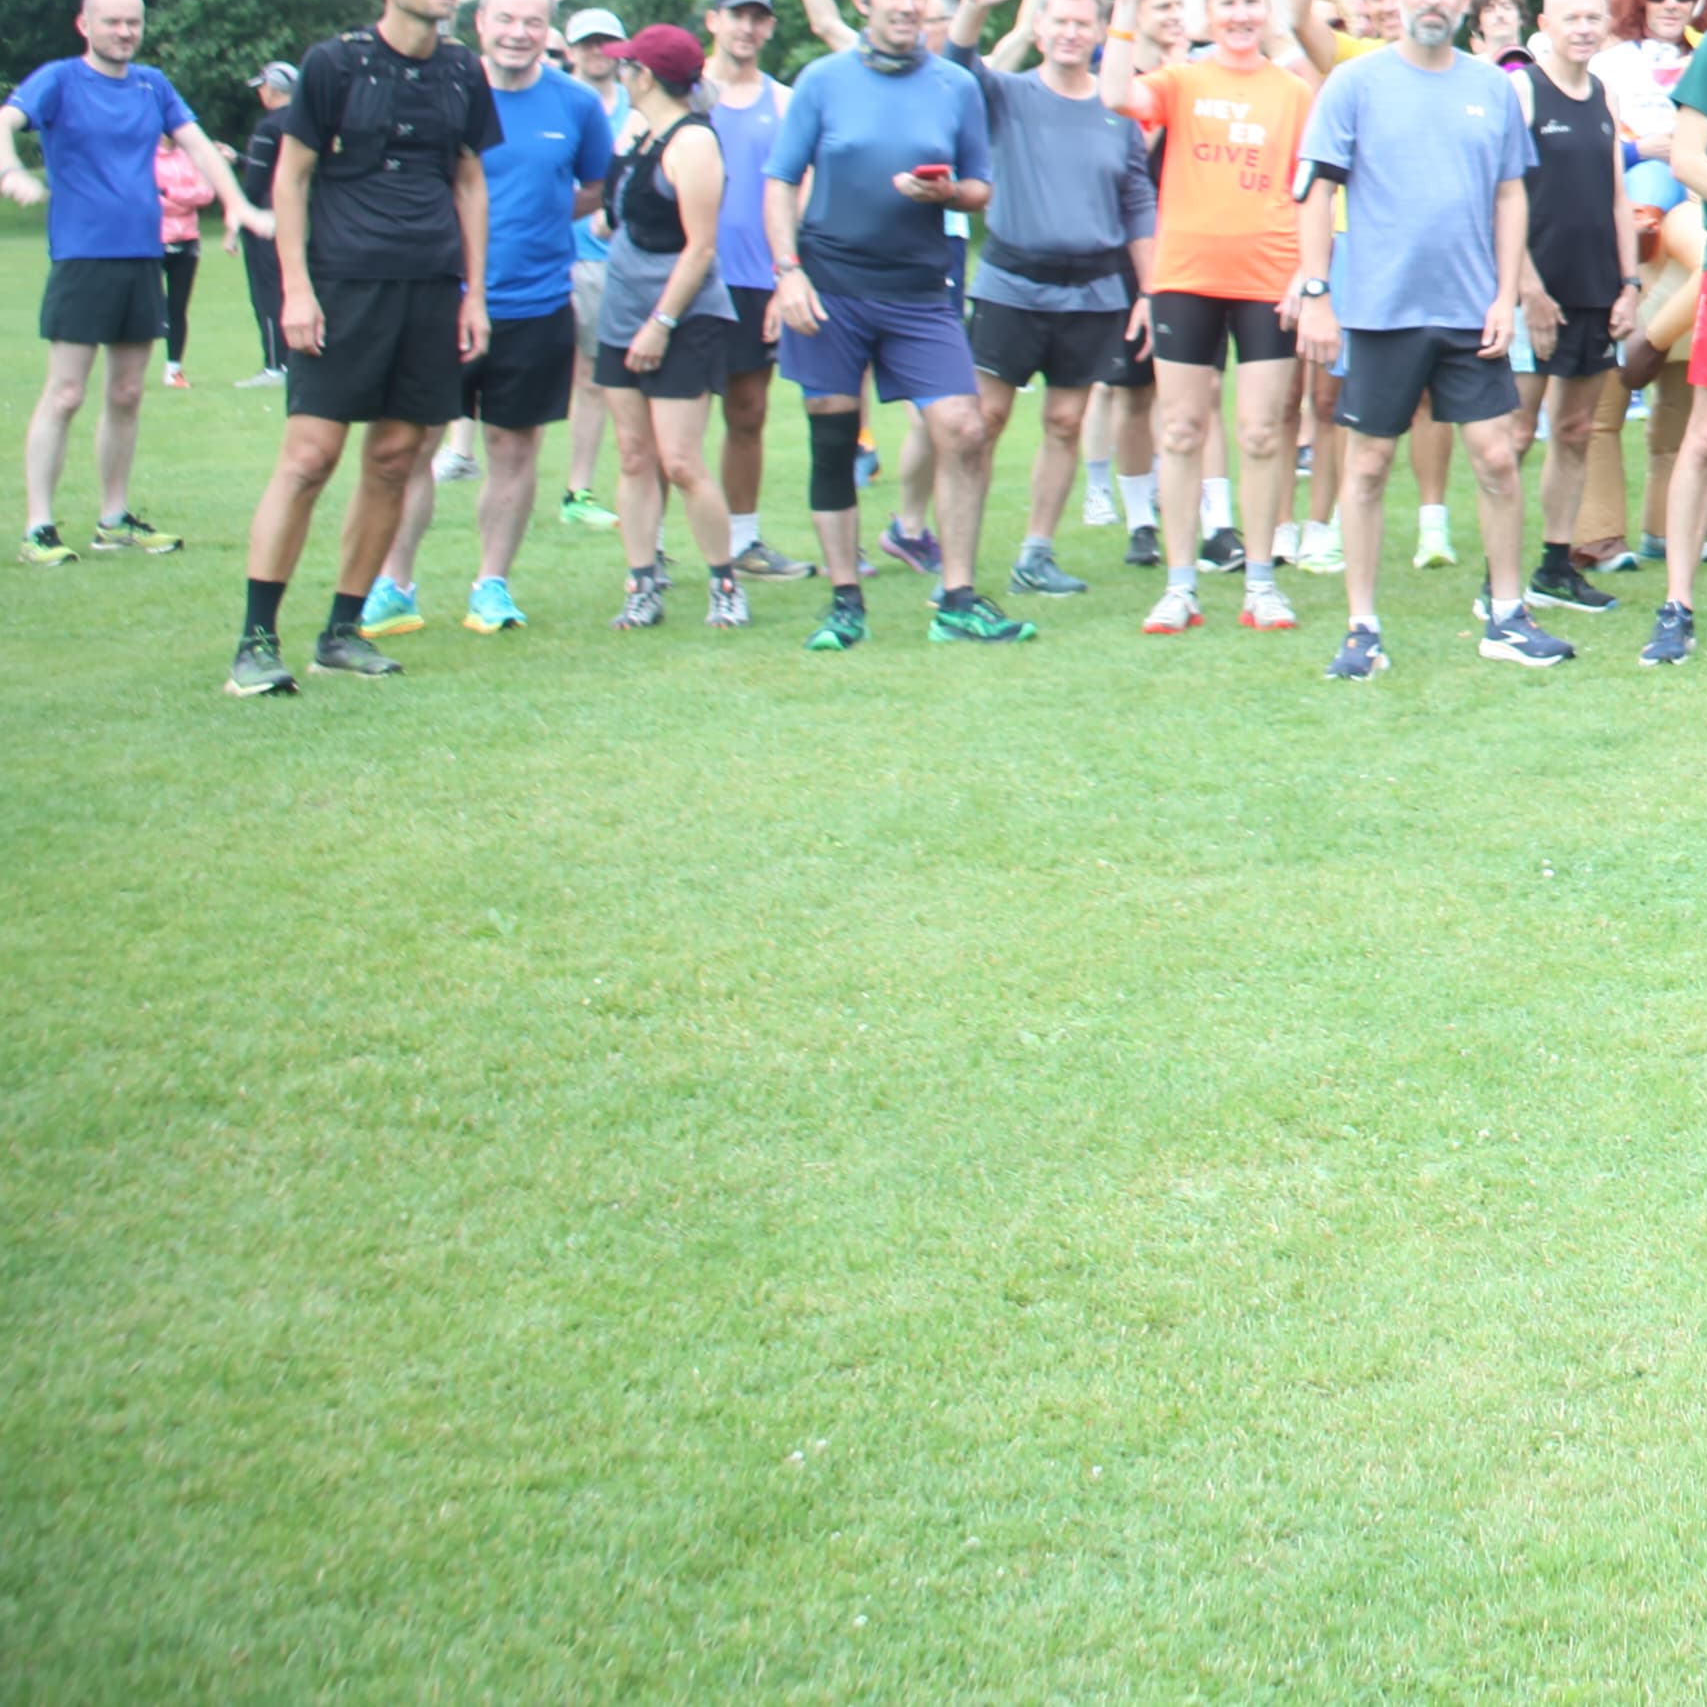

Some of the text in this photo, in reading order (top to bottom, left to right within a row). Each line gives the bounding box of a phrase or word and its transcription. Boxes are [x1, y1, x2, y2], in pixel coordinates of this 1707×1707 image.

[1194, 98, 1252, 119] NEV
[1229, 121, 1266, 146] ER
[1193, 143, 1259, 167] GIVE
[1240, 170, 1270, 192] UP
